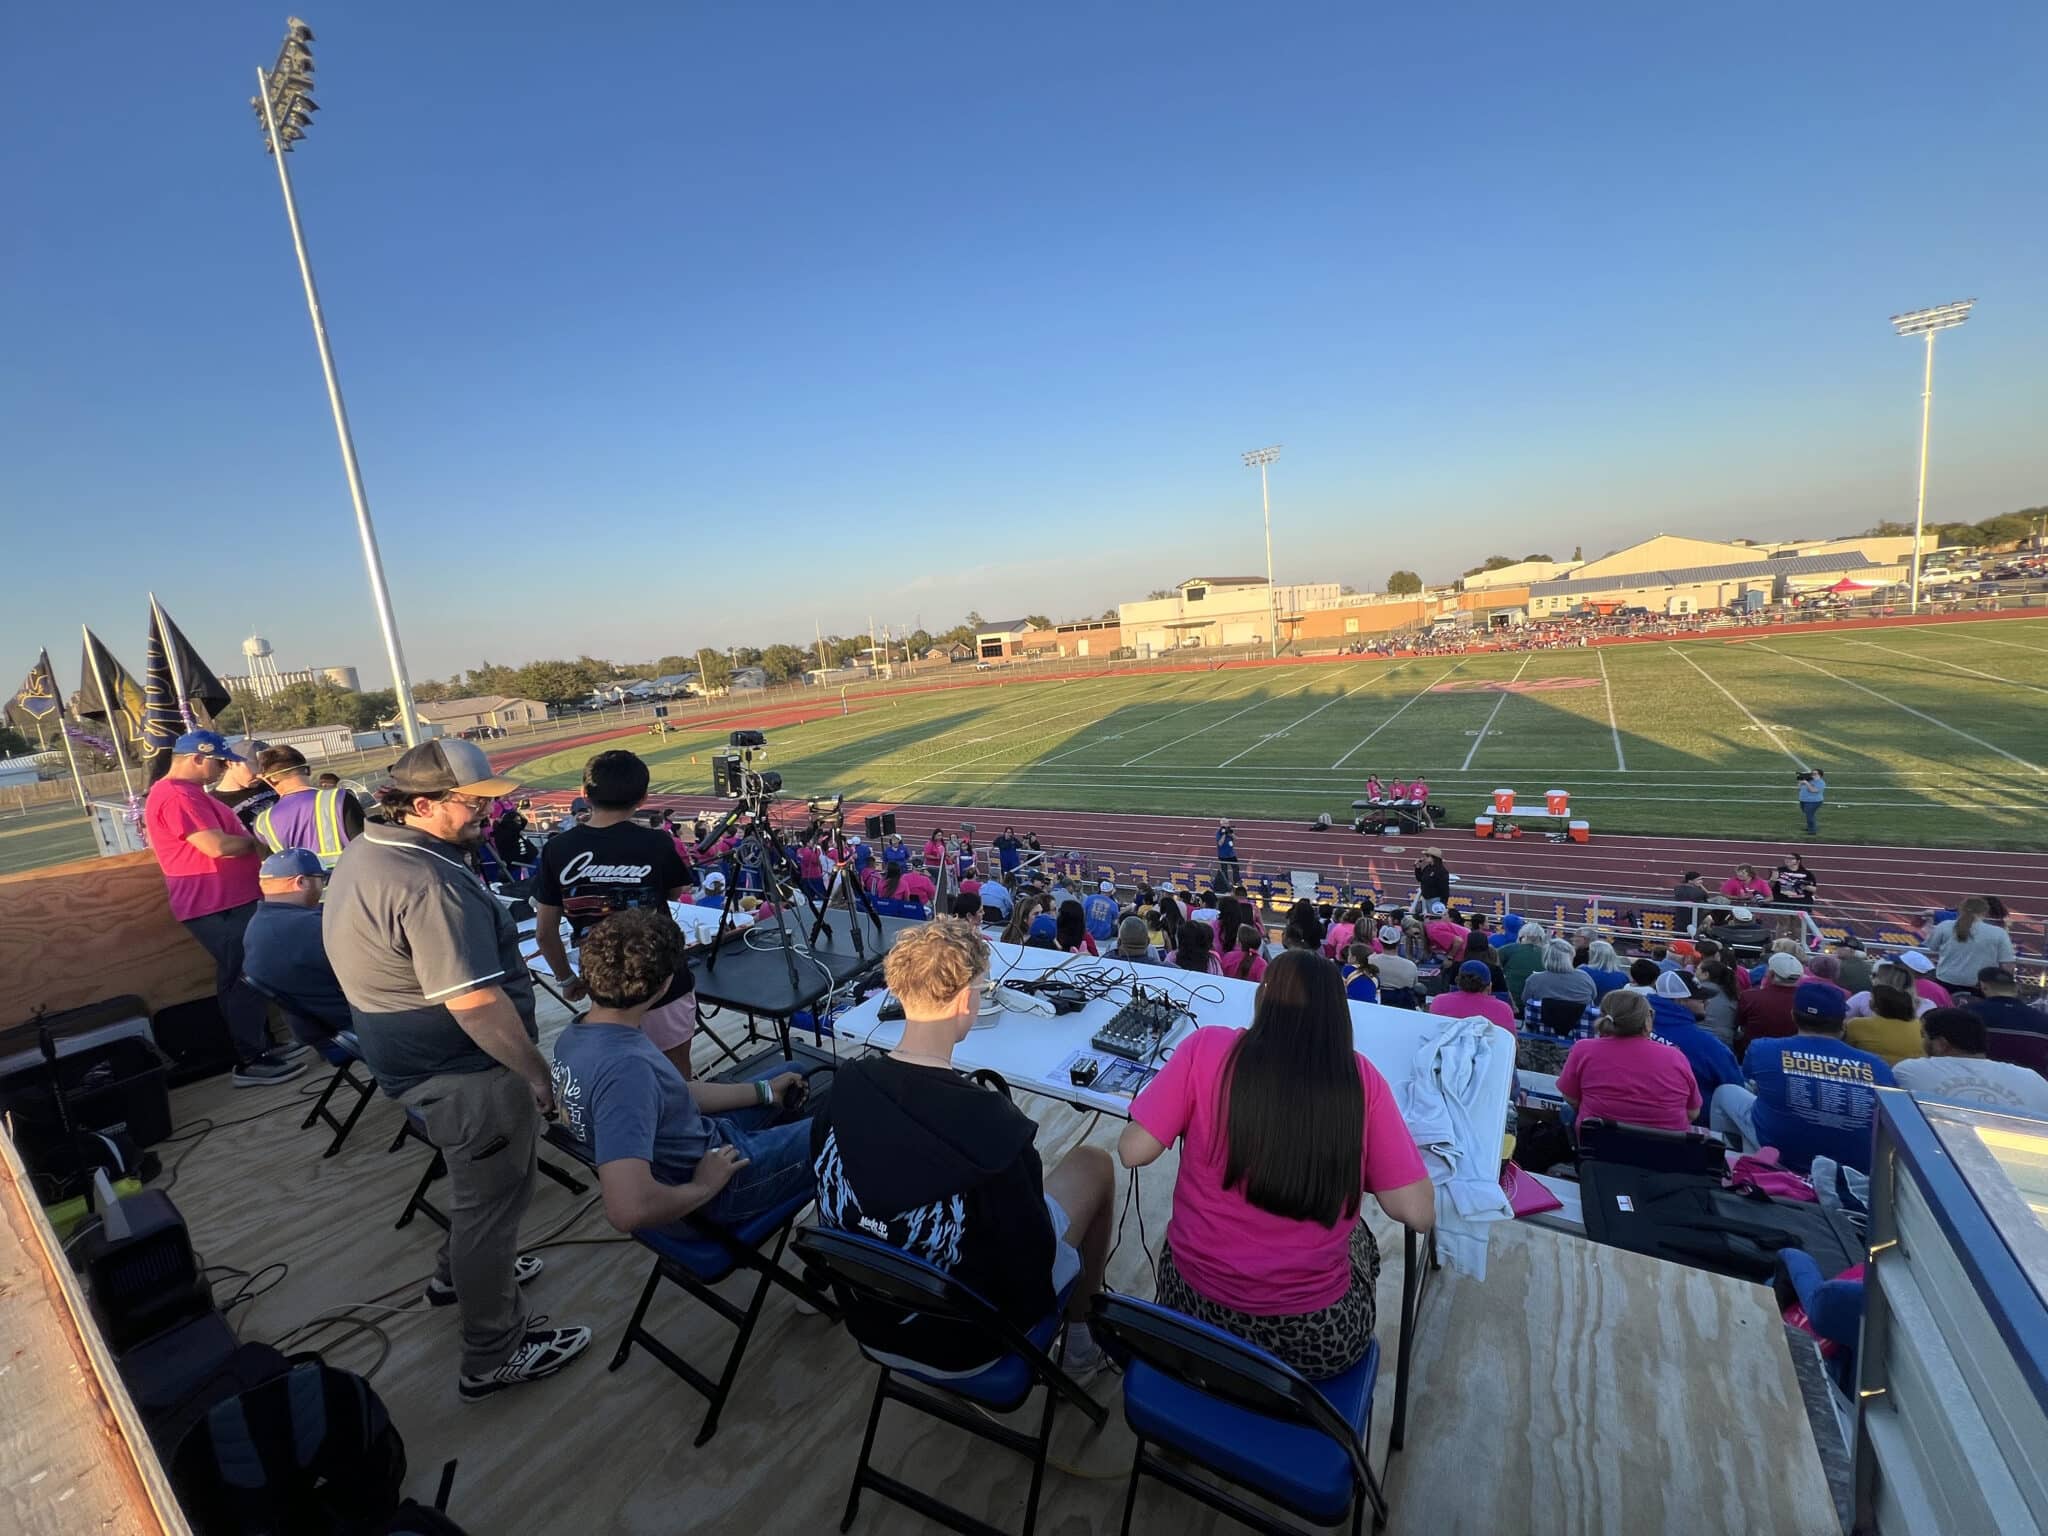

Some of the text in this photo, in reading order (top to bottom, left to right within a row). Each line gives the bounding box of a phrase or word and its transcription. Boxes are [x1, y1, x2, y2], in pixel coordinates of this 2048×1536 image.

[560, 851, 652, 885] Camaro
[1782, 1056, 1874, 1081] BOBCATS
[1792, 1051, 1860, 1067] SUNRAY
